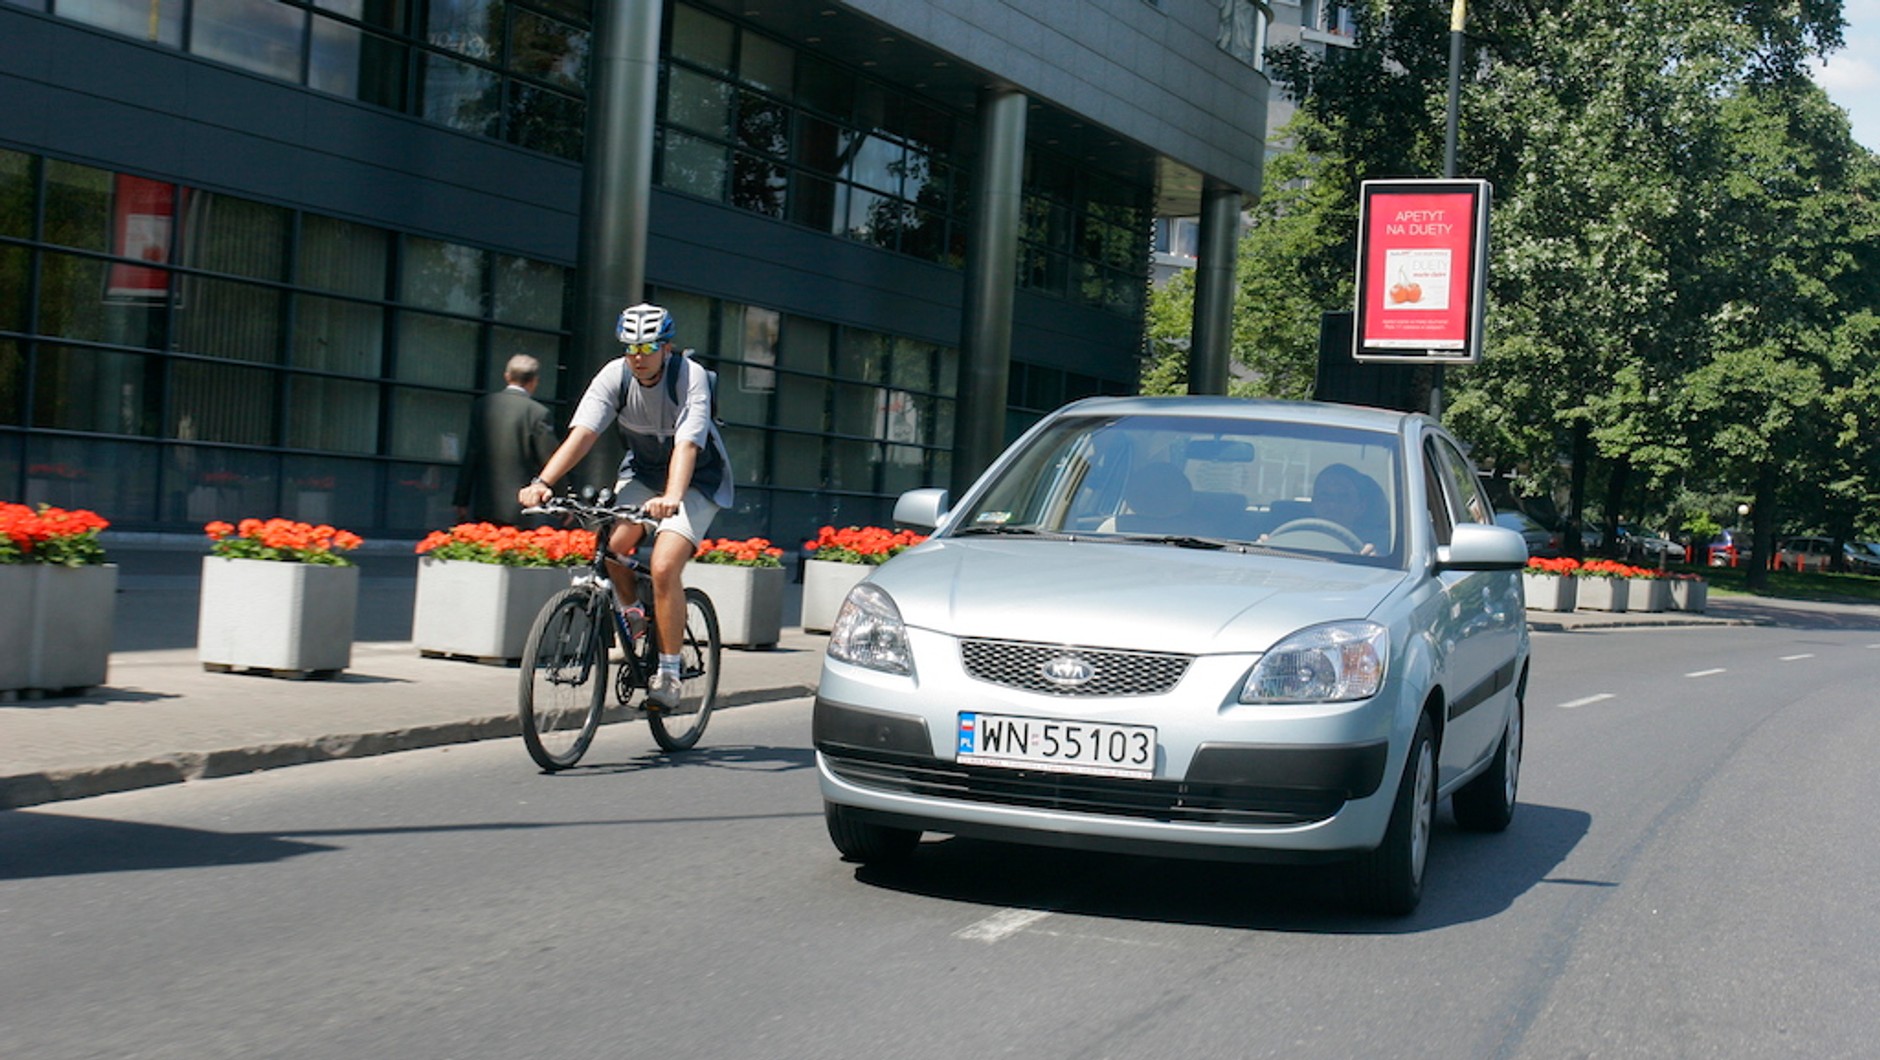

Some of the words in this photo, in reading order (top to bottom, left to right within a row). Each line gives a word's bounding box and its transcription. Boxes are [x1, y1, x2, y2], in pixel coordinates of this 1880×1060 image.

[1395, 210, 1445, 222] APETYT
[1386, 224, 1405, 235] NA
[1409, 224, 1453, 236] DUETY
[1052, 663, 1084, 678] KIA
[960, 737, 973, 748] PL
[982, 719, 1028, 754] WN
[1042, 724, 1149, 764] 55103
